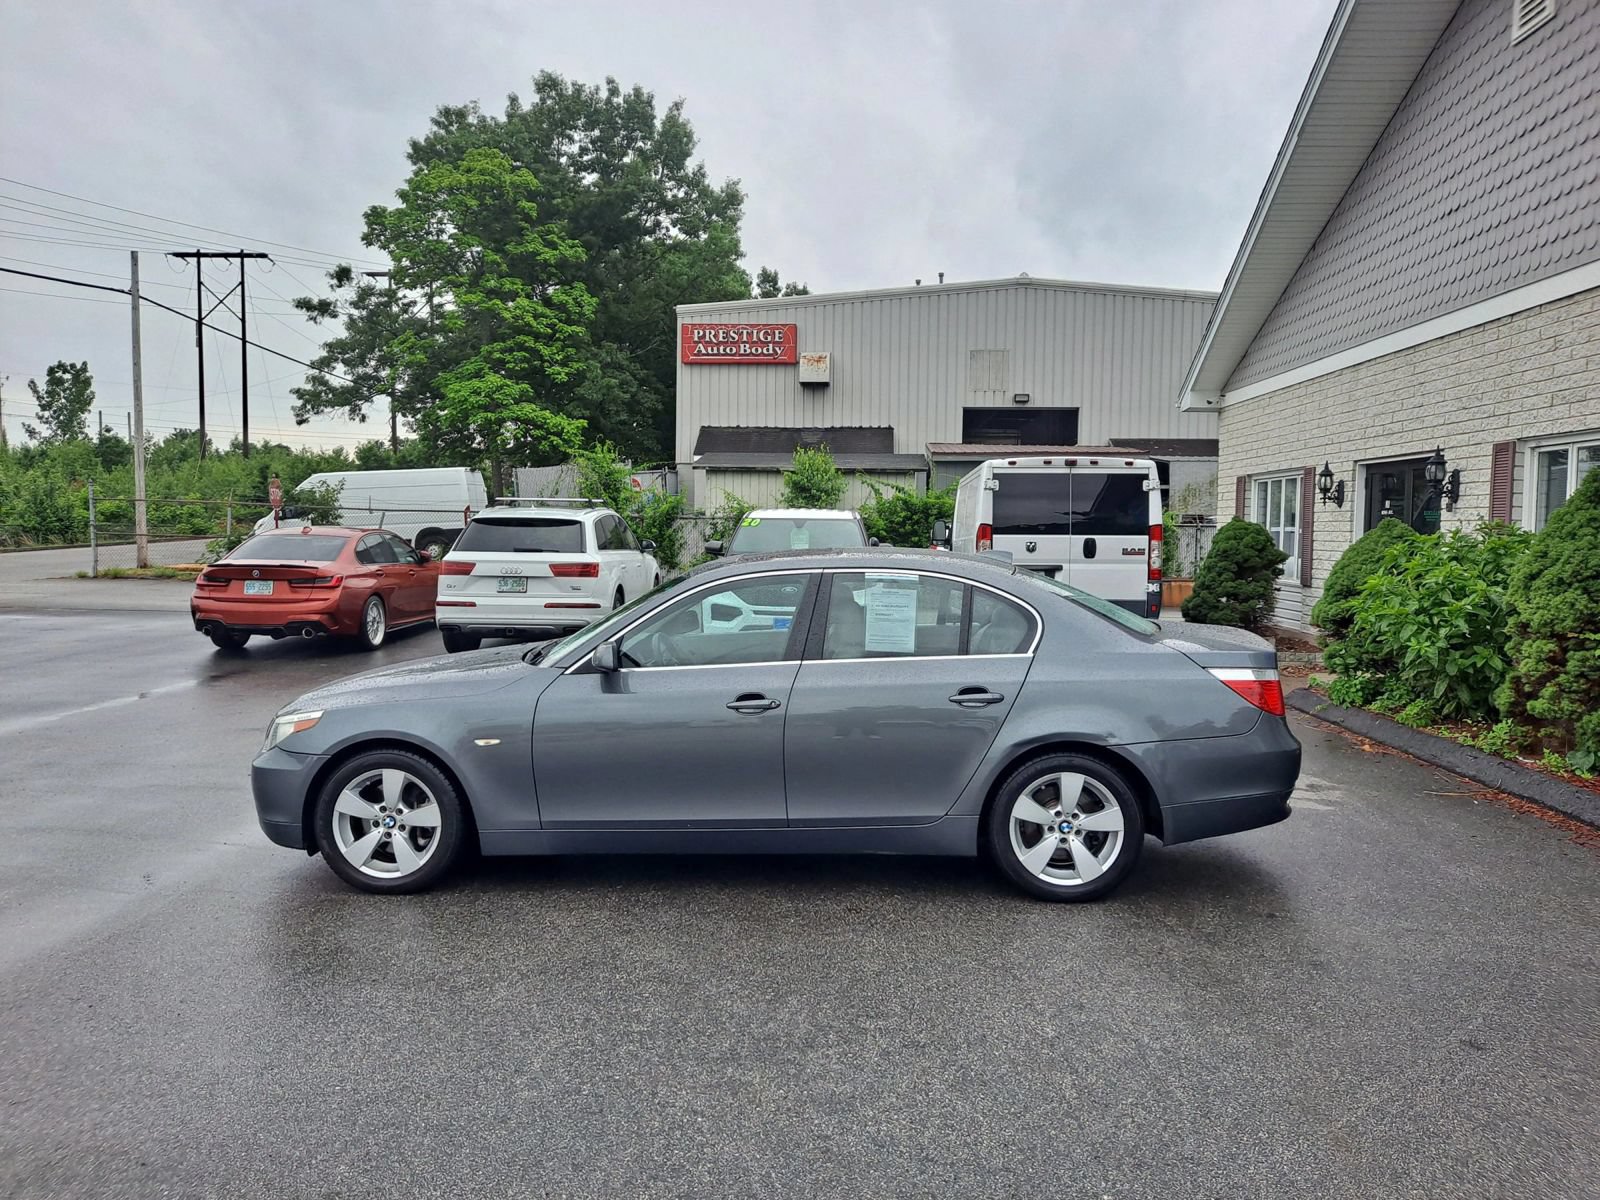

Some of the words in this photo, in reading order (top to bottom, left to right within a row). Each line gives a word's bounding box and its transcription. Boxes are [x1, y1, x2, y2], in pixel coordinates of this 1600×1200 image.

[693, 329, 784, 343] PRESTIGE
[693, 343, 737, 354] Auto
[739, 343, 784, 359] Body
